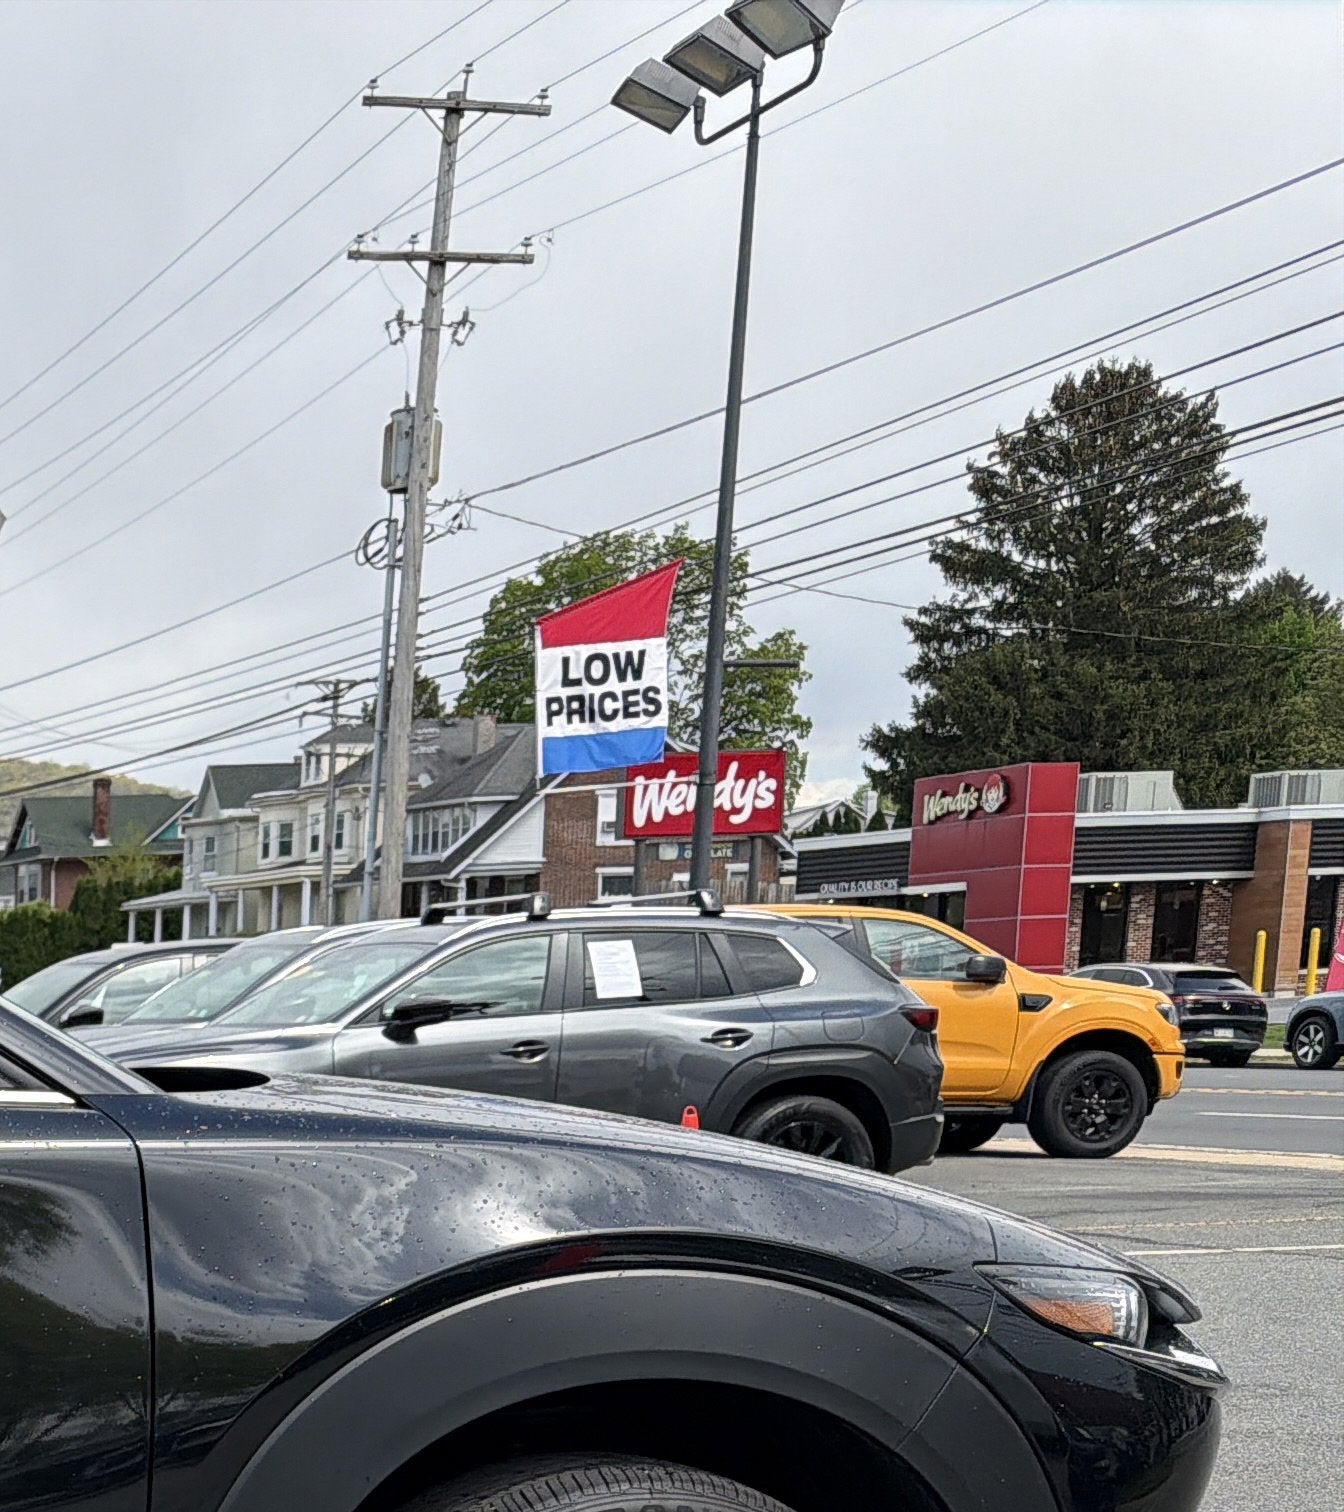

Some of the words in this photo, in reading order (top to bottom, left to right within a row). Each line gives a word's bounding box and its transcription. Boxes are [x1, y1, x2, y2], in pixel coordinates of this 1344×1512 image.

[561, 649, 646, 688] LOW
[546, 686, 662, 727] PRICES
[923, 782, 979, 824] Wendy's
